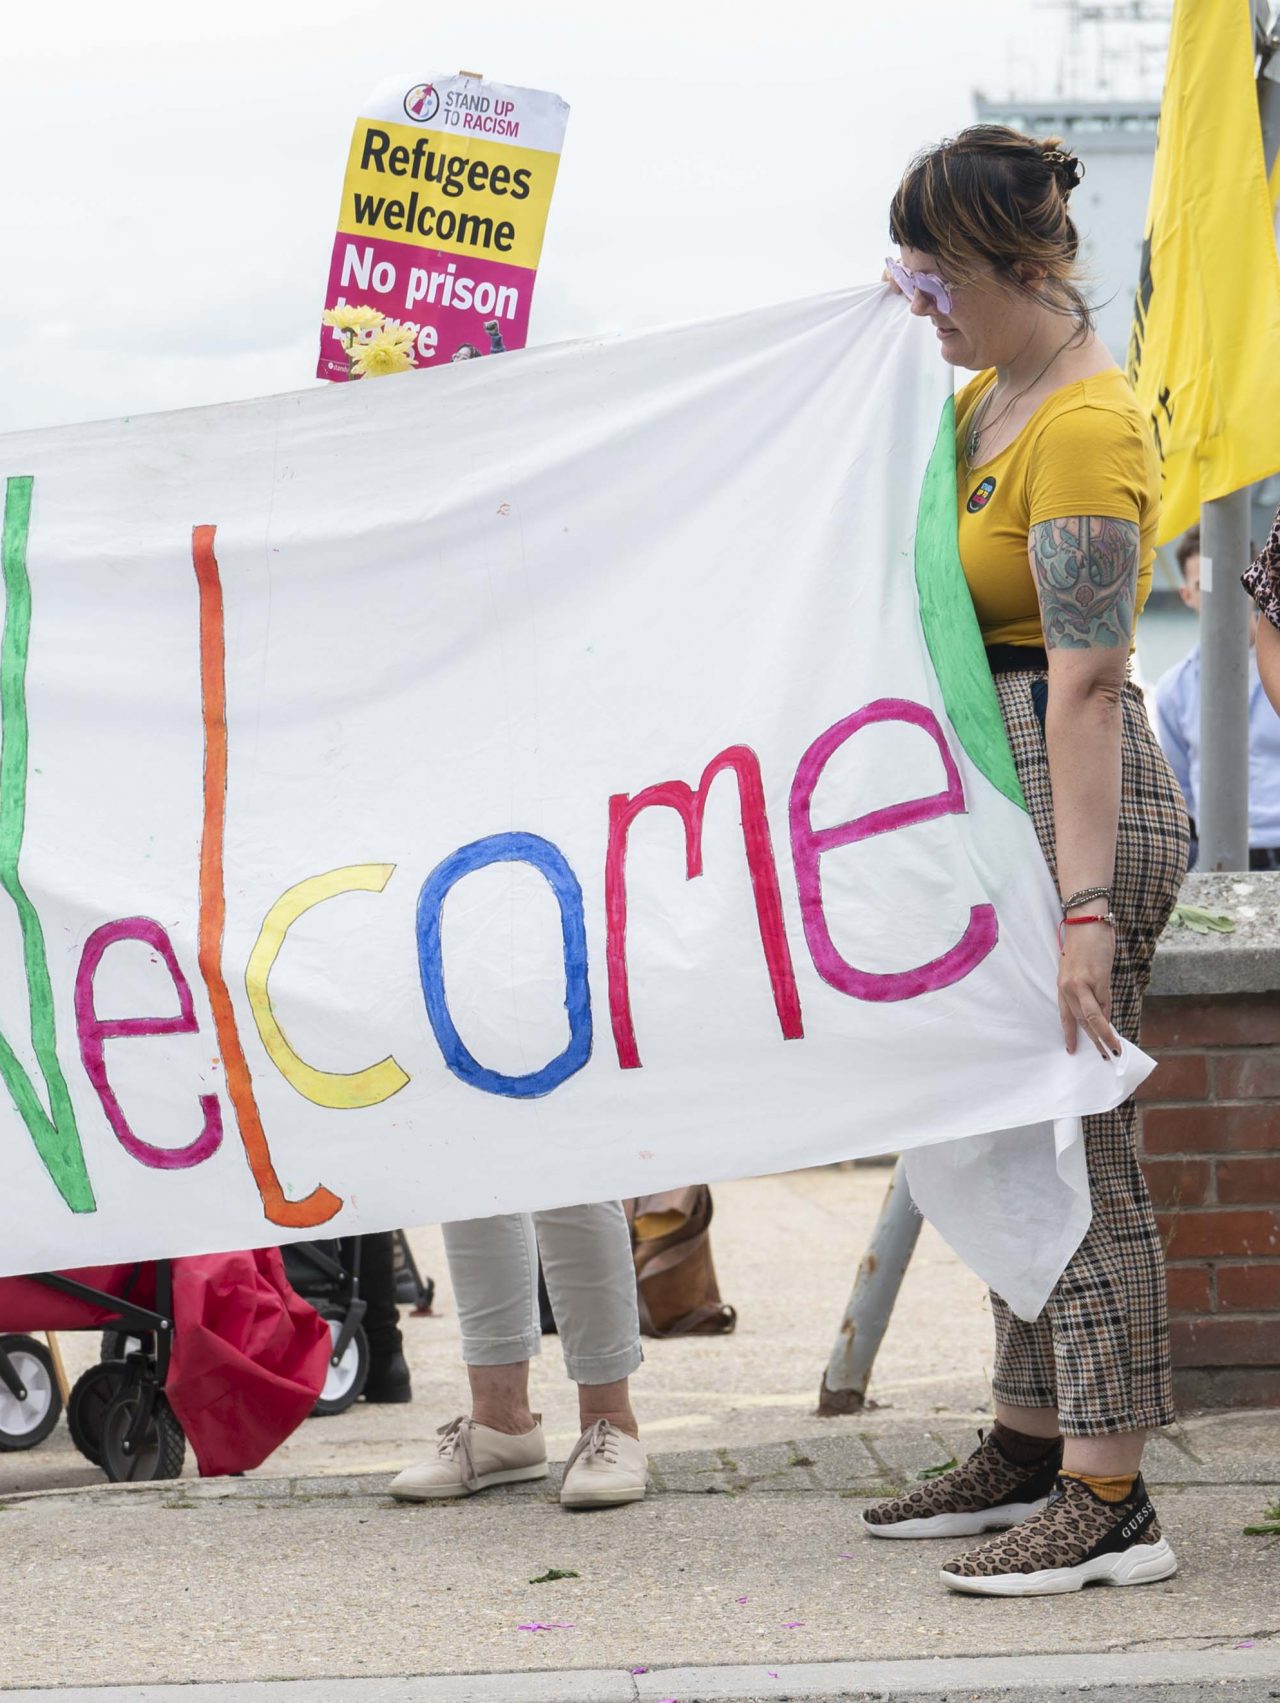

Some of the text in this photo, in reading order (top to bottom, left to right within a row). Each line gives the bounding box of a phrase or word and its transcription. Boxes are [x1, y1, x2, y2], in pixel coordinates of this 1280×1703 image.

[444, 108, 520, 138] TO RACISM
[445, 91, 515, 117] STAND UP
[360, 128, 533, 200] Refugees
[353, 192, 515, 252] welcome
[340, 243, 519, 320] No prison
[1122, 1501, 1153, 1538] GUESS
